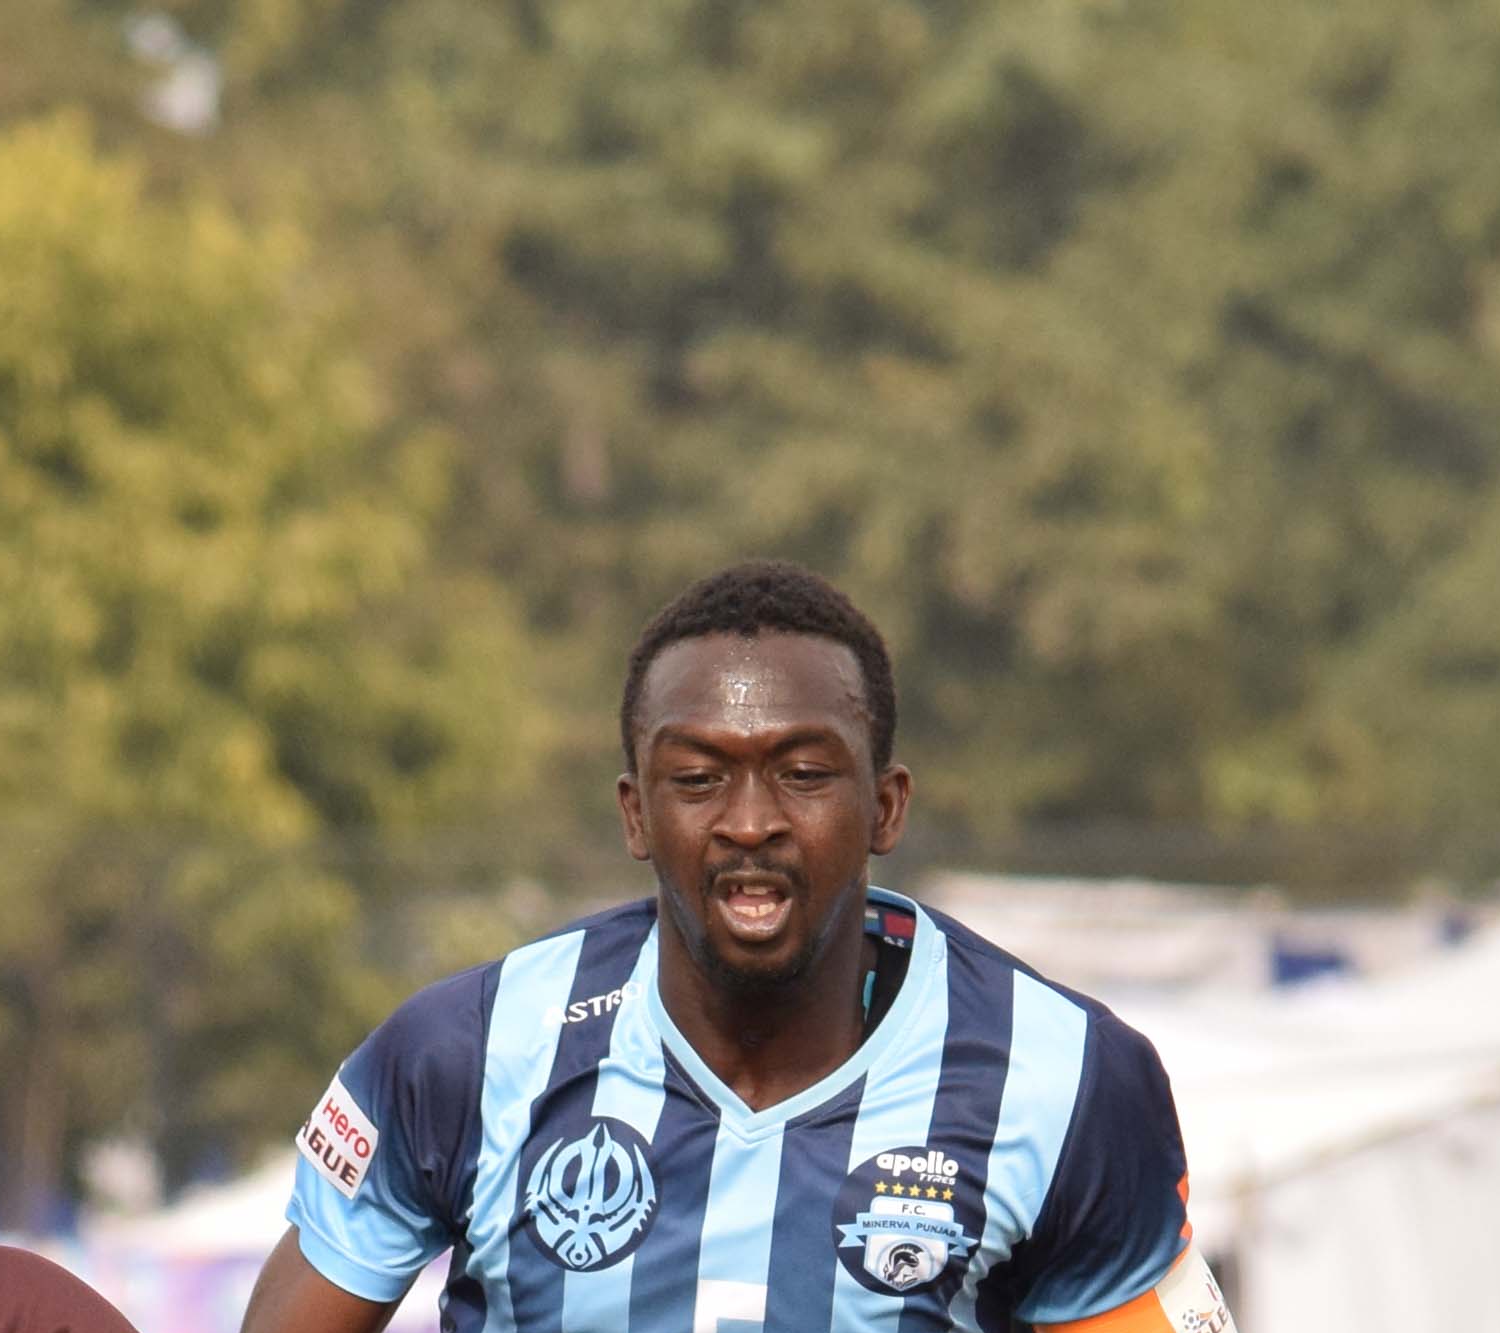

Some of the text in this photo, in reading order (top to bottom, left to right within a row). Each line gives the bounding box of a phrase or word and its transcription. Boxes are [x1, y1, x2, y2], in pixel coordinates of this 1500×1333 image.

[321, 1097, 371, 1159] Hero
[876, 1150, 959, 1177] apollo
[919, 1173, 956, 1185] TYRES
[901, 1203, 926, 1216] F.C.
[862, 1219, 957, 1238] MINERVA PUNJAB
